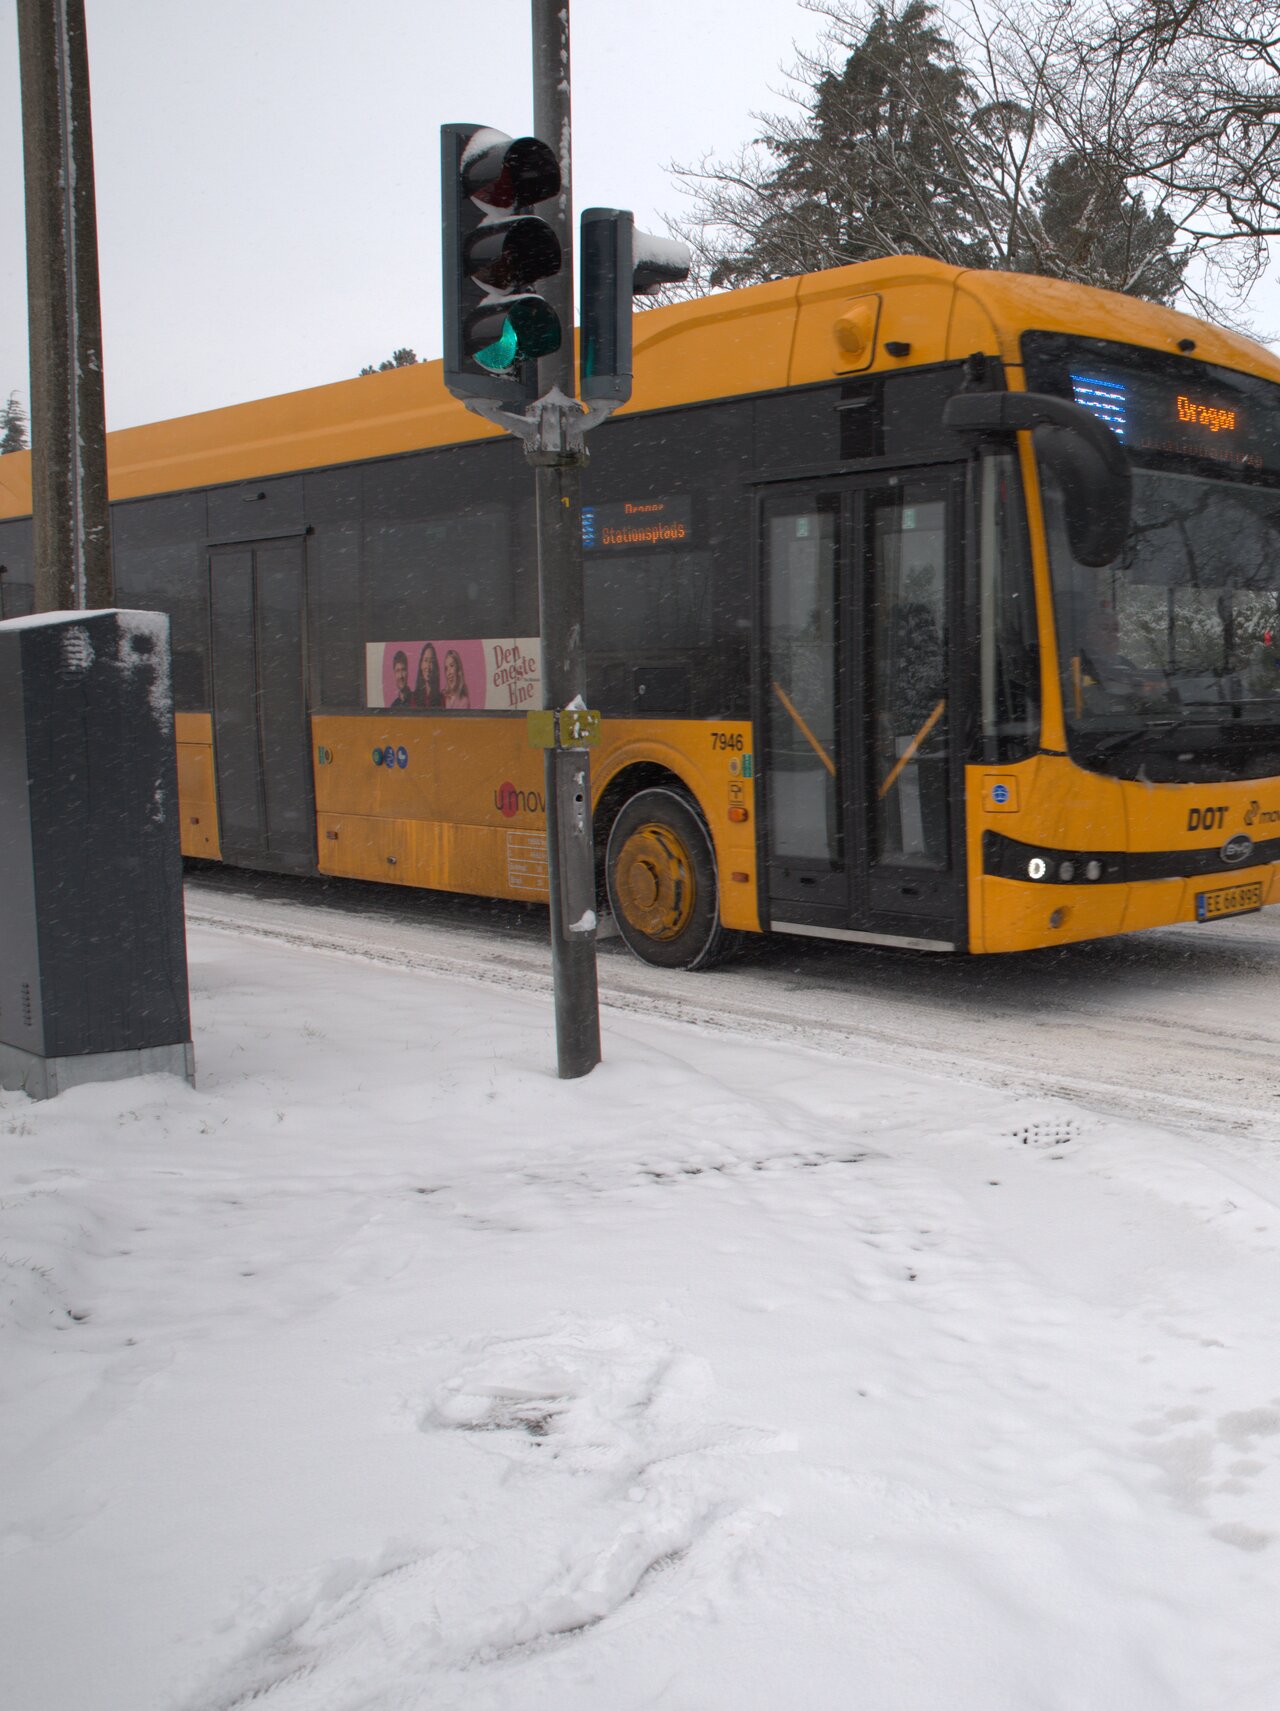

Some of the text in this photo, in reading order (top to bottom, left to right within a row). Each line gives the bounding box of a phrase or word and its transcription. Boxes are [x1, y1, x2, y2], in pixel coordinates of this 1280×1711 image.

[492, 645, 521, 669] Den
[493, 656, 537, 687] eneste
[710, 732, 744, 752] 7946
[1186, 806, 1230, 832] DOT
